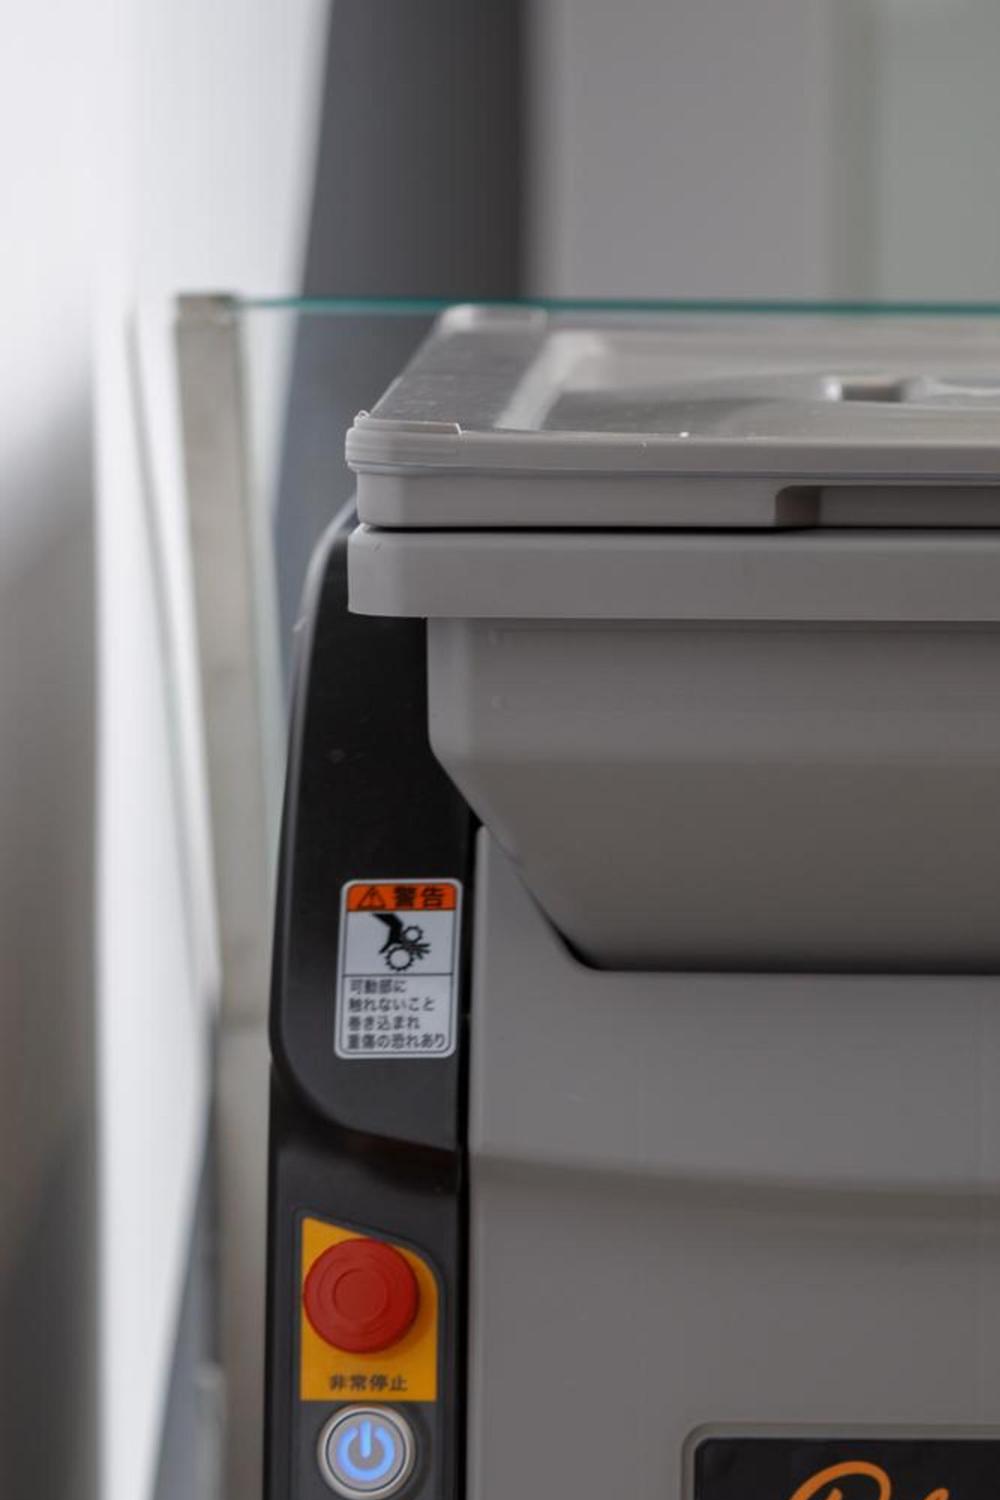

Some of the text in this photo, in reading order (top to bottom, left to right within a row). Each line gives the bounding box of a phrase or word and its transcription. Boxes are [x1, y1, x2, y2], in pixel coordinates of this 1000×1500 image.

[393, 885, 444, 910] 警告
[349, 978, 408, 995] 可動部に
[348, 996, 435, 1013] 触れないこと
[329, 1374, 408, 1391] 非常停止
